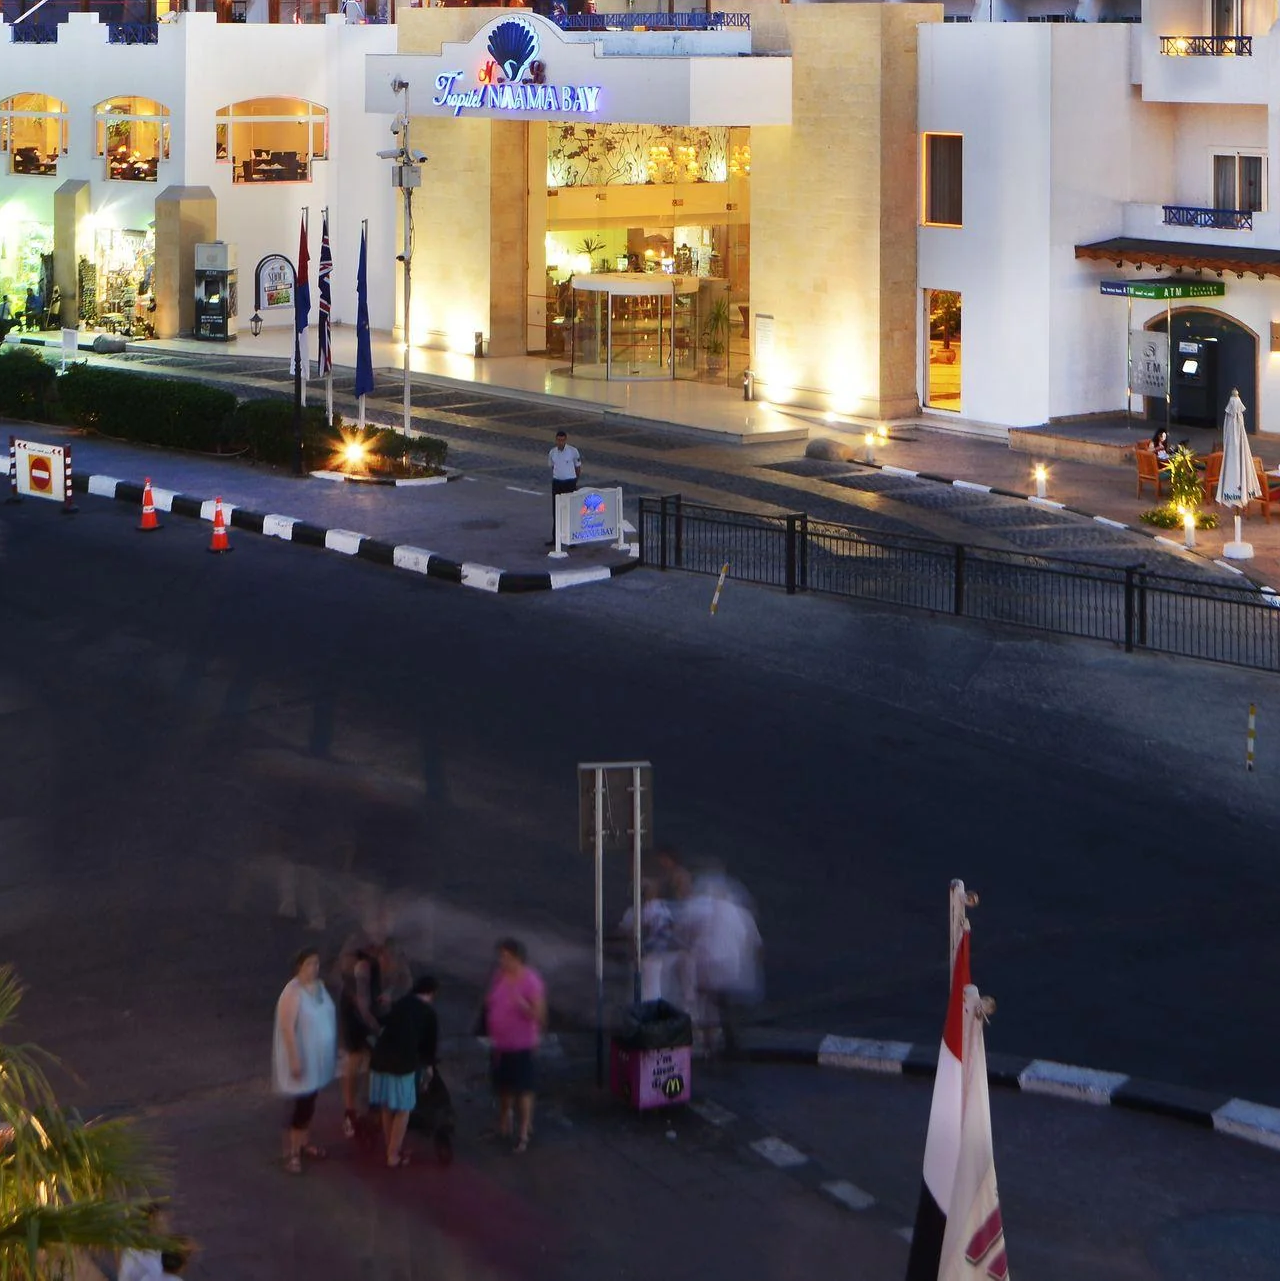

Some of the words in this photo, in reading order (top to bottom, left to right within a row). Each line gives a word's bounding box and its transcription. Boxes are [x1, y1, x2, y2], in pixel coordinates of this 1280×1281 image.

[433, 70, 488, 116] Tropitel
[487, 84, 560, 111] NAAMA
[561, 86, 601, 113] BAY
[1163, 287, 1183, 298] ATM
